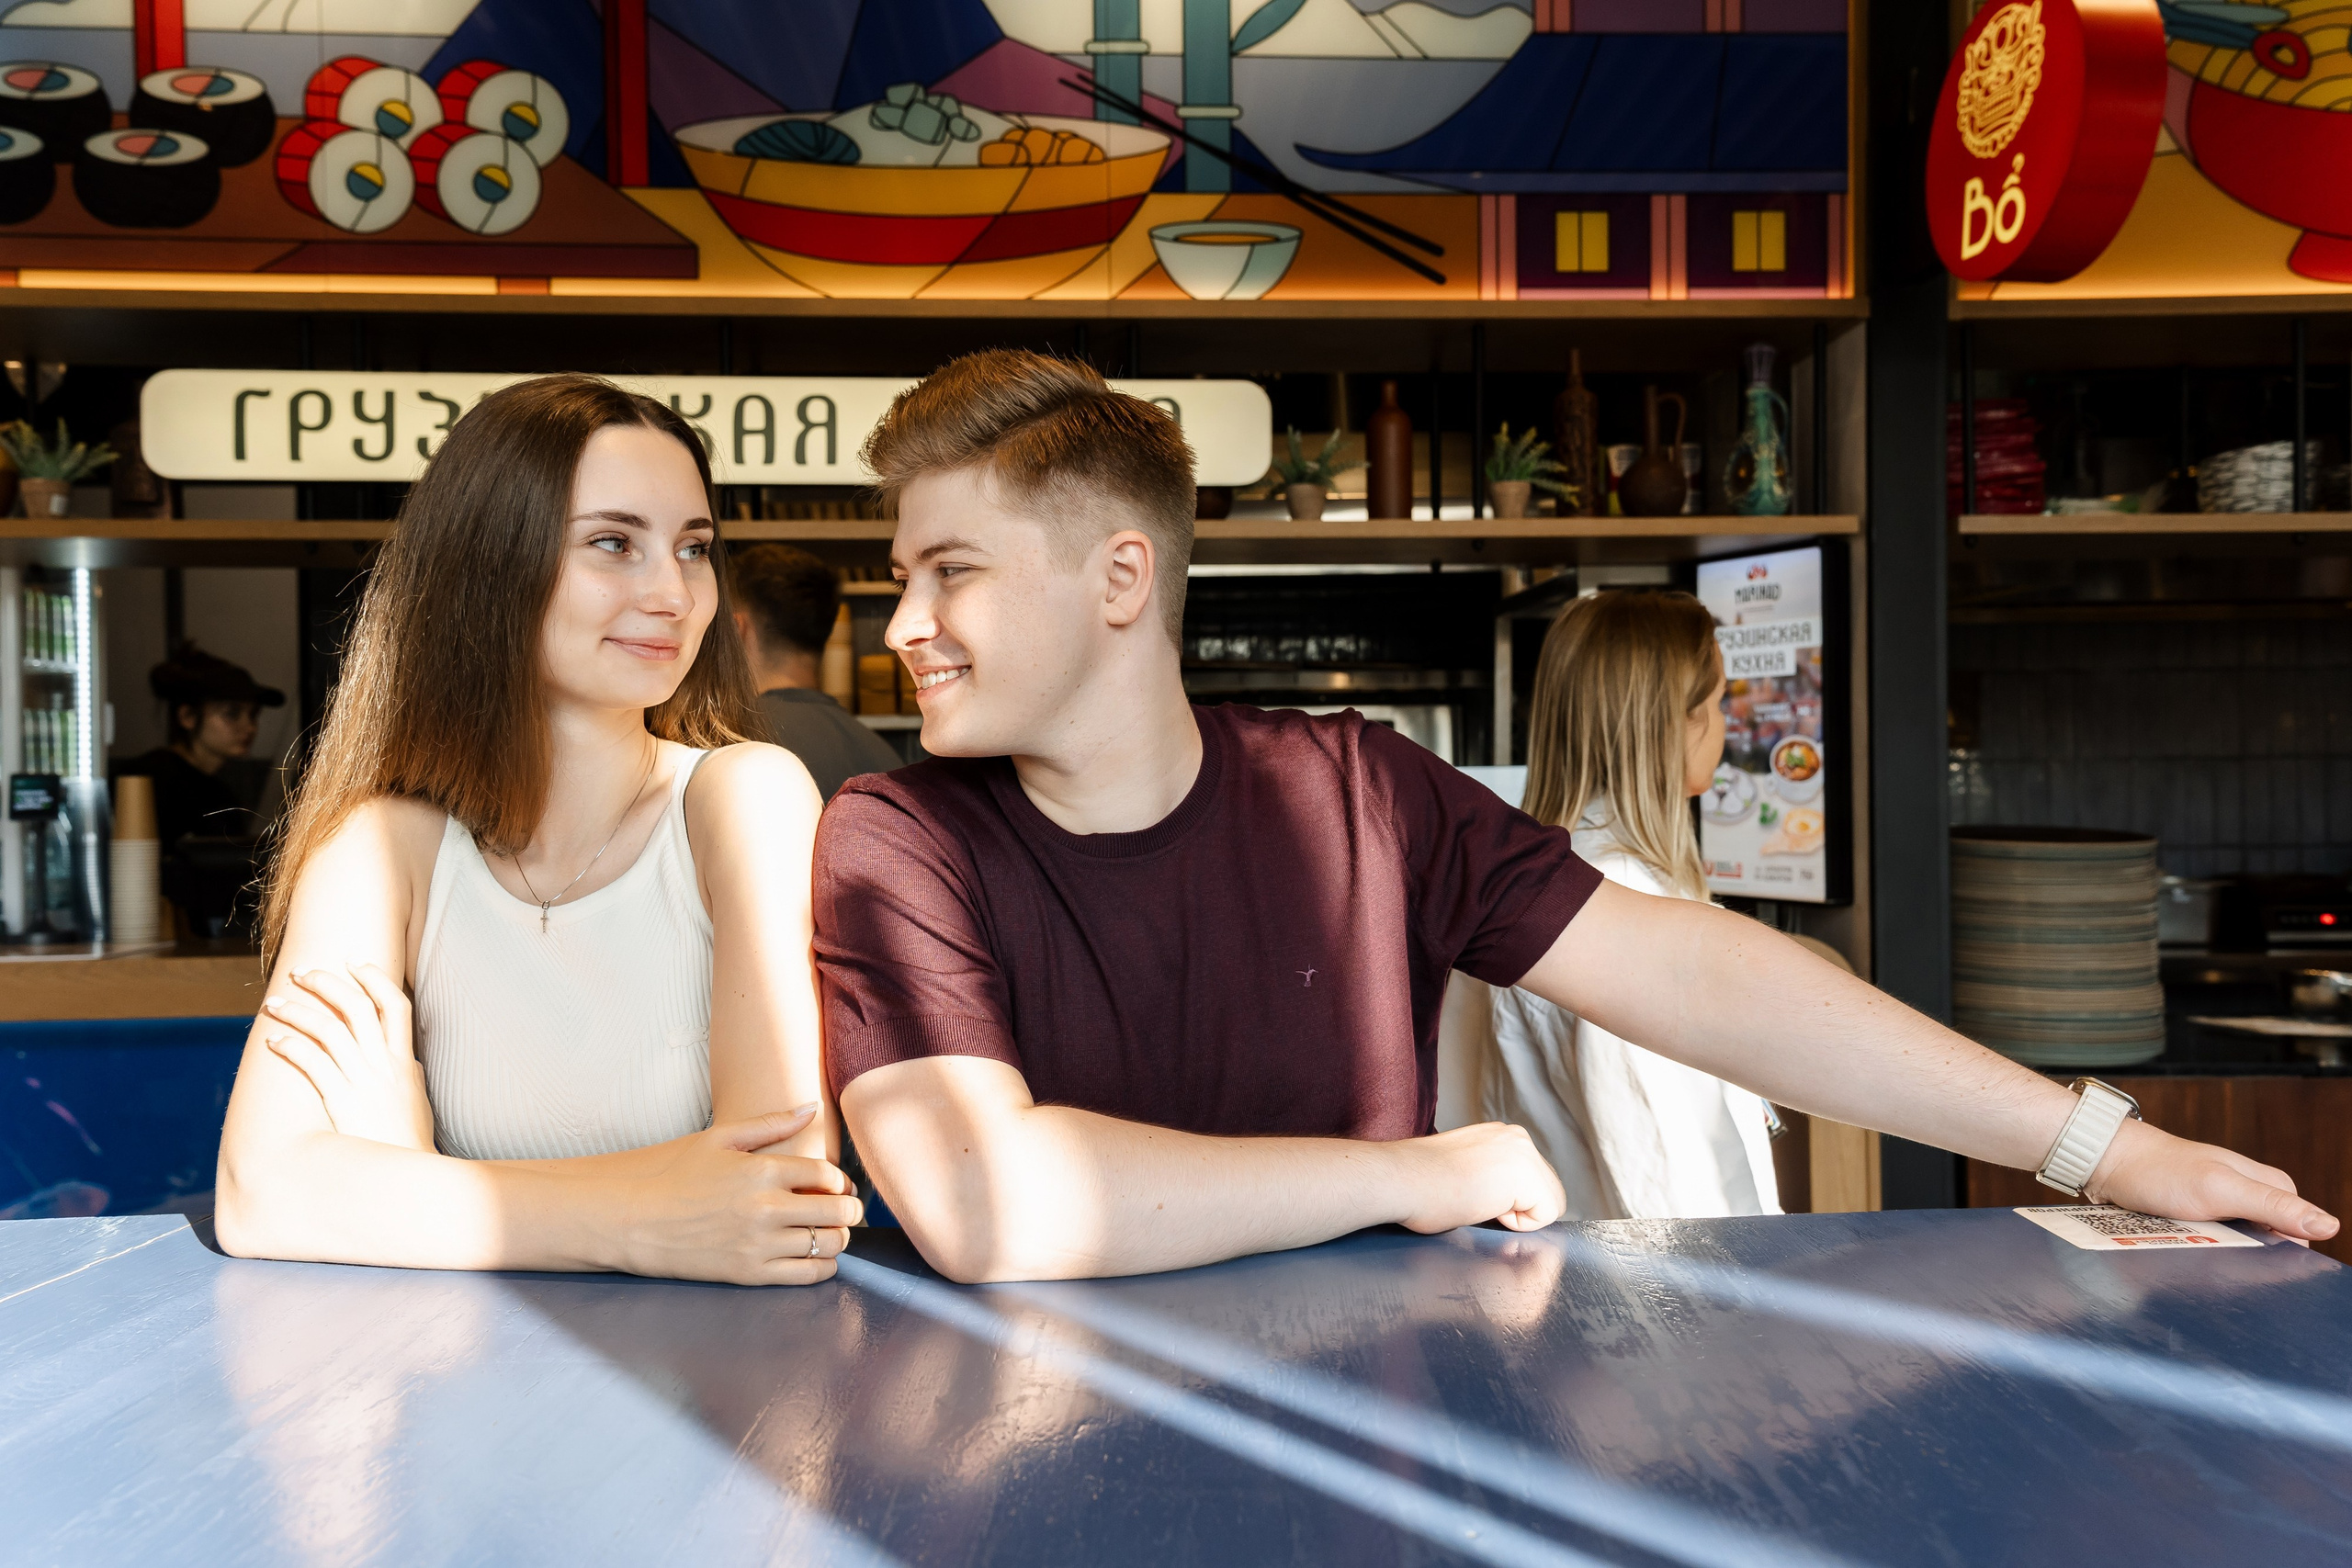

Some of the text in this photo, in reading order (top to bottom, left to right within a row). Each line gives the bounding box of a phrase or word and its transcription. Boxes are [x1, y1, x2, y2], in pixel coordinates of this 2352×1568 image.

[233, 389, 837, 466] ГРУЗКАЯ
[1715, 620, 1813, 649] РУЗИНСКАЯ
[1732, 650, 1786, 673] КУХНЯ
